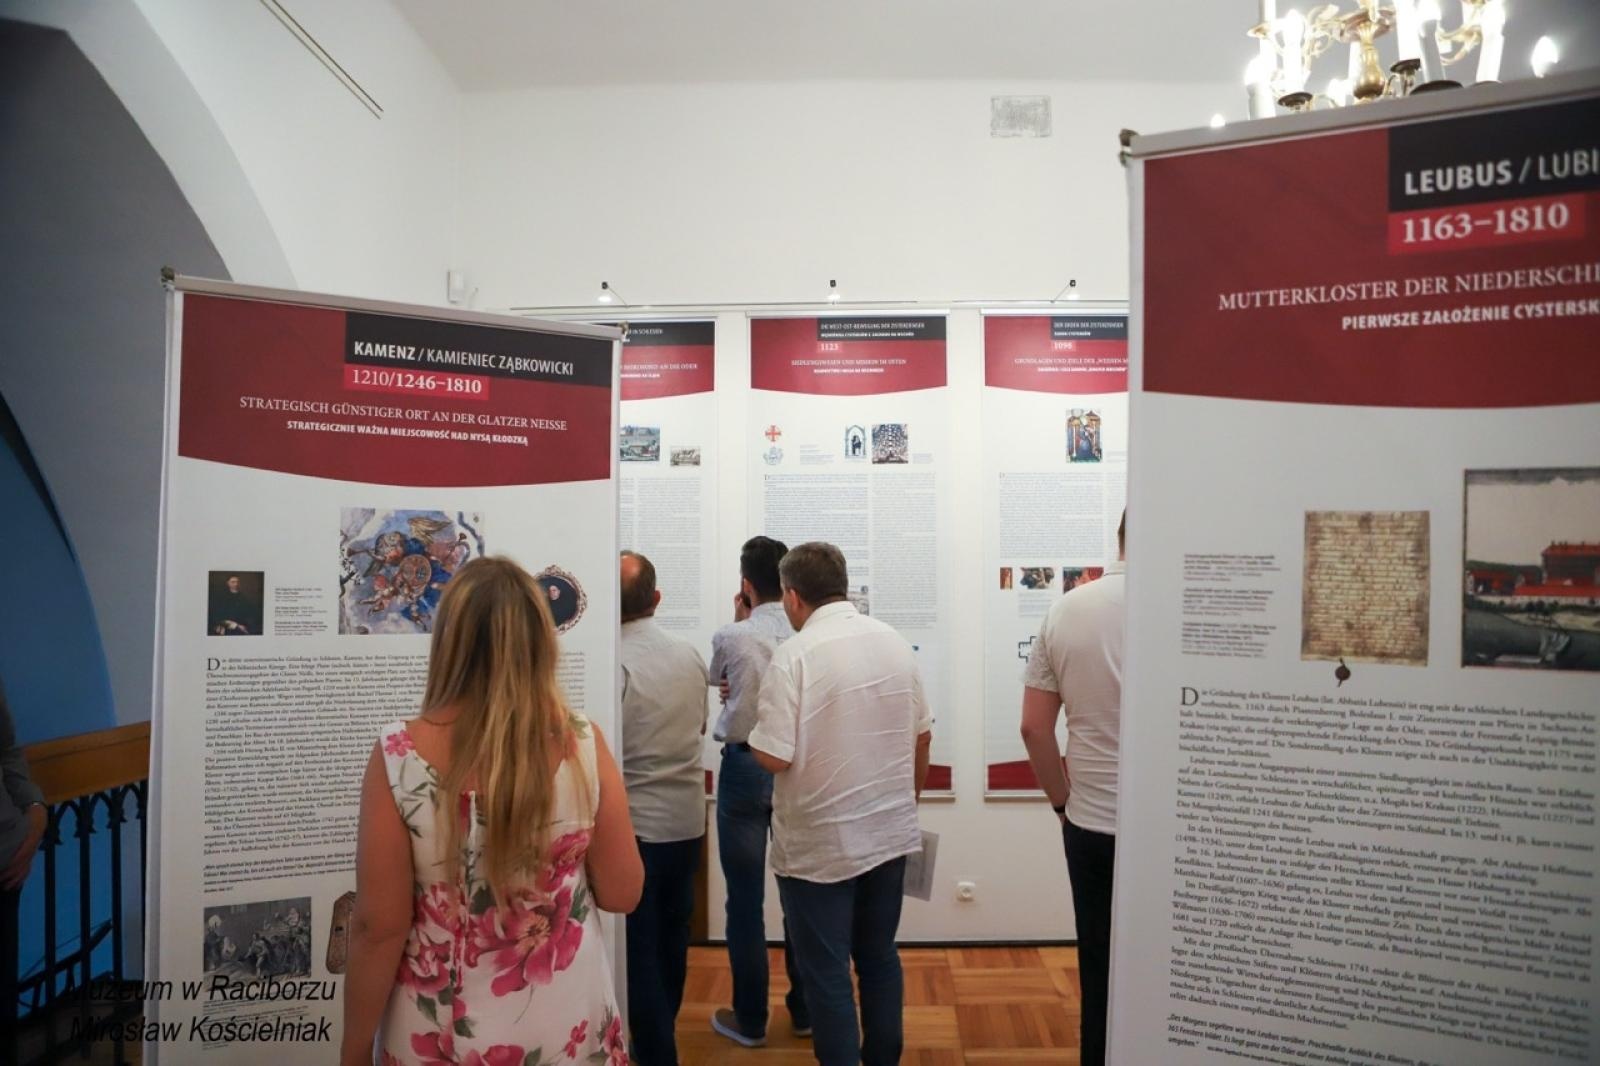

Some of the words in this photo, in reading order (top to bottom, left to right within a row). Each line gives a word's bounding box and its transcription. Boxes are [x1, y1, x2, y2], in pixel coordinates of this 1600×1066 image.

[1404, 160, 1512, 195] LEUBUS
[1537, 148, 1600, 181] LUBI
[1218, 279, 1399, 311] MUTTERKLOSTER
[1404, 275, 1449, 297] DER
[1341, 311, 1419, 331] PIERWSZE
[1421, 304, 1510, 326] ZAŁOŻENIE
[1513, 299, 1600, 321] CYSTERSK
[353, 340, 416, 361] KAMENZ
[426, 348, 496, 369] KAMIENIEC
[498, 354, 574, 376] ZĄBKOWICKI
[239, 395, 329, 415] STRATEGISCH
[331, 401, 403, 420] GÜNSTIGER
[404, 408, 430, 422] ORT
[432, 410, 450, 422] AN
[452, 411, 477, 423] DER
[477, 413, 528, 429] GLATZER
[530, 416, 568, 431] NEISSE
[287, 420, 356, 434] STRATEGICZNIE
[357, 422, 389, 436] WAŻNA
[390, 425, 450, 441] MIEJSCOWOŚĆ
[451, 431, 469, 441] NAD
[470, 432, 491, 444] NYSĄ
[492, 434, 528, 446] KŁODZKĄ
